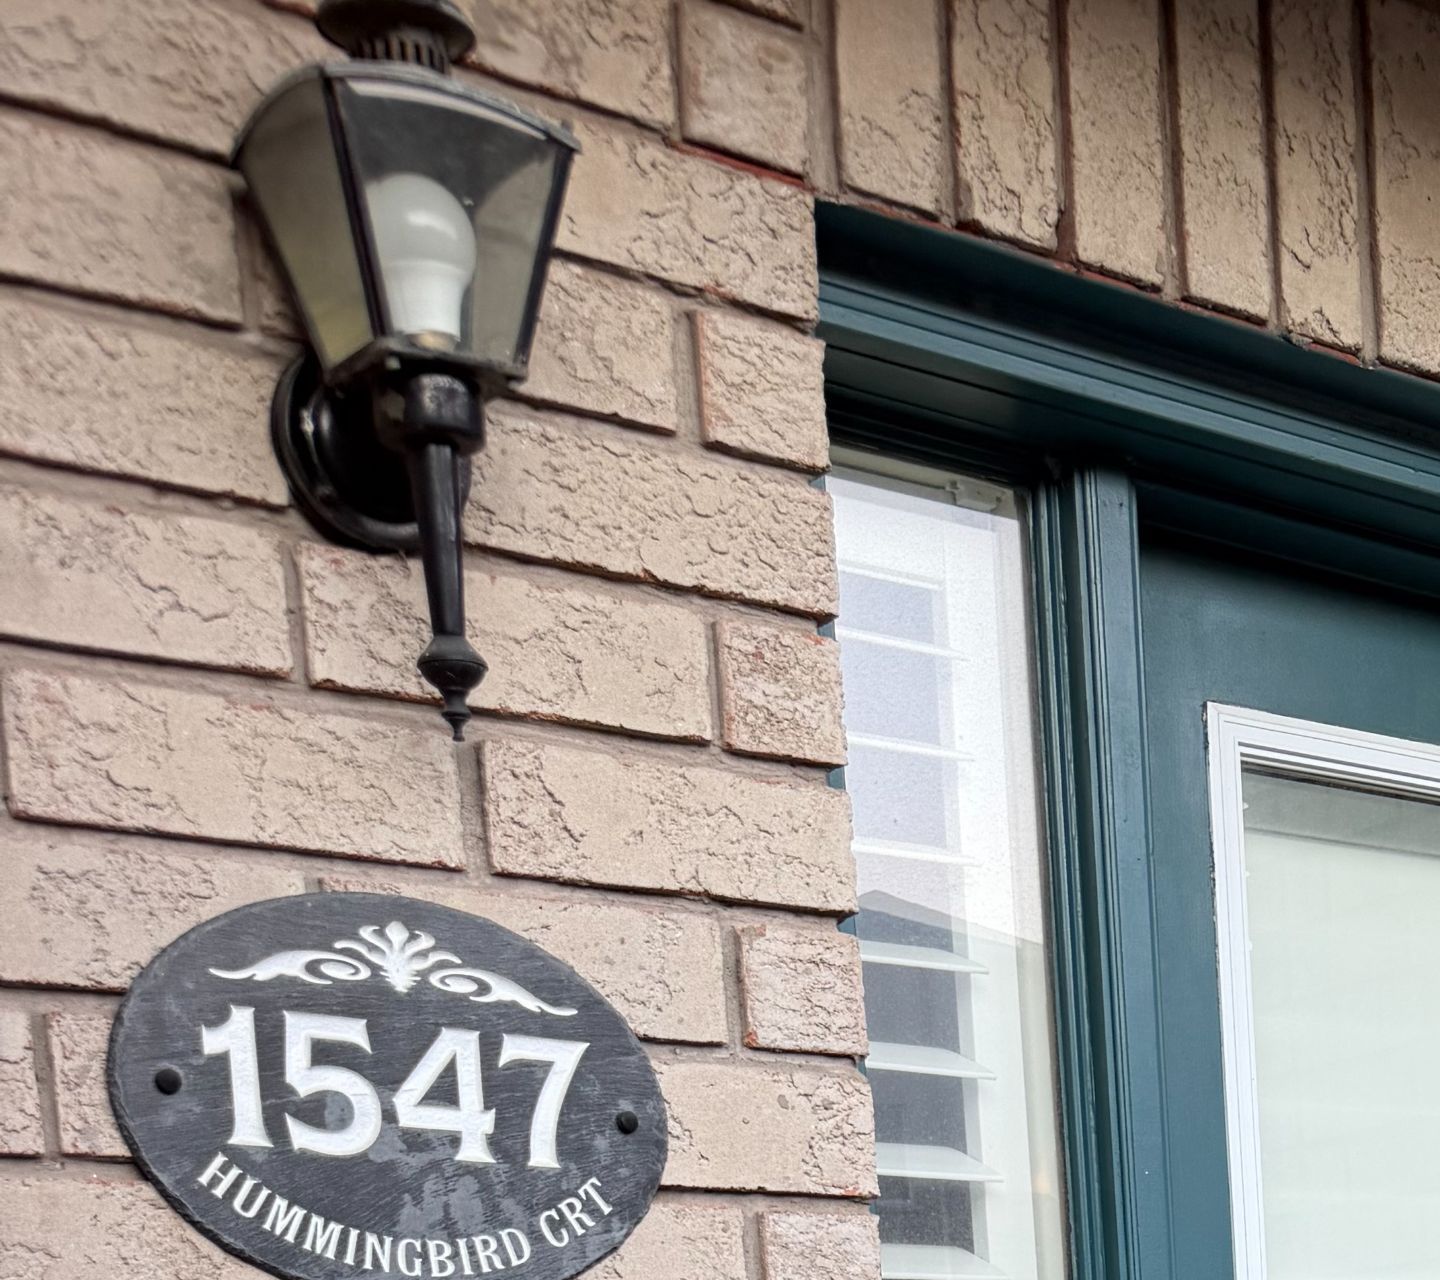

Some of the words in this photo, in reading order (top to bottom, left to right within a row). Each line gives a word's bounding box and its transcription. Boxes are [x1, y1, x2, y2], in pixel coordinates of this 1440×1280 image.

[200, 1004, 591, 1169] 1547
[197, 1151, 532, 1278] HUMMINGBIRD
[538, 1176, 614, 1248] CRT
